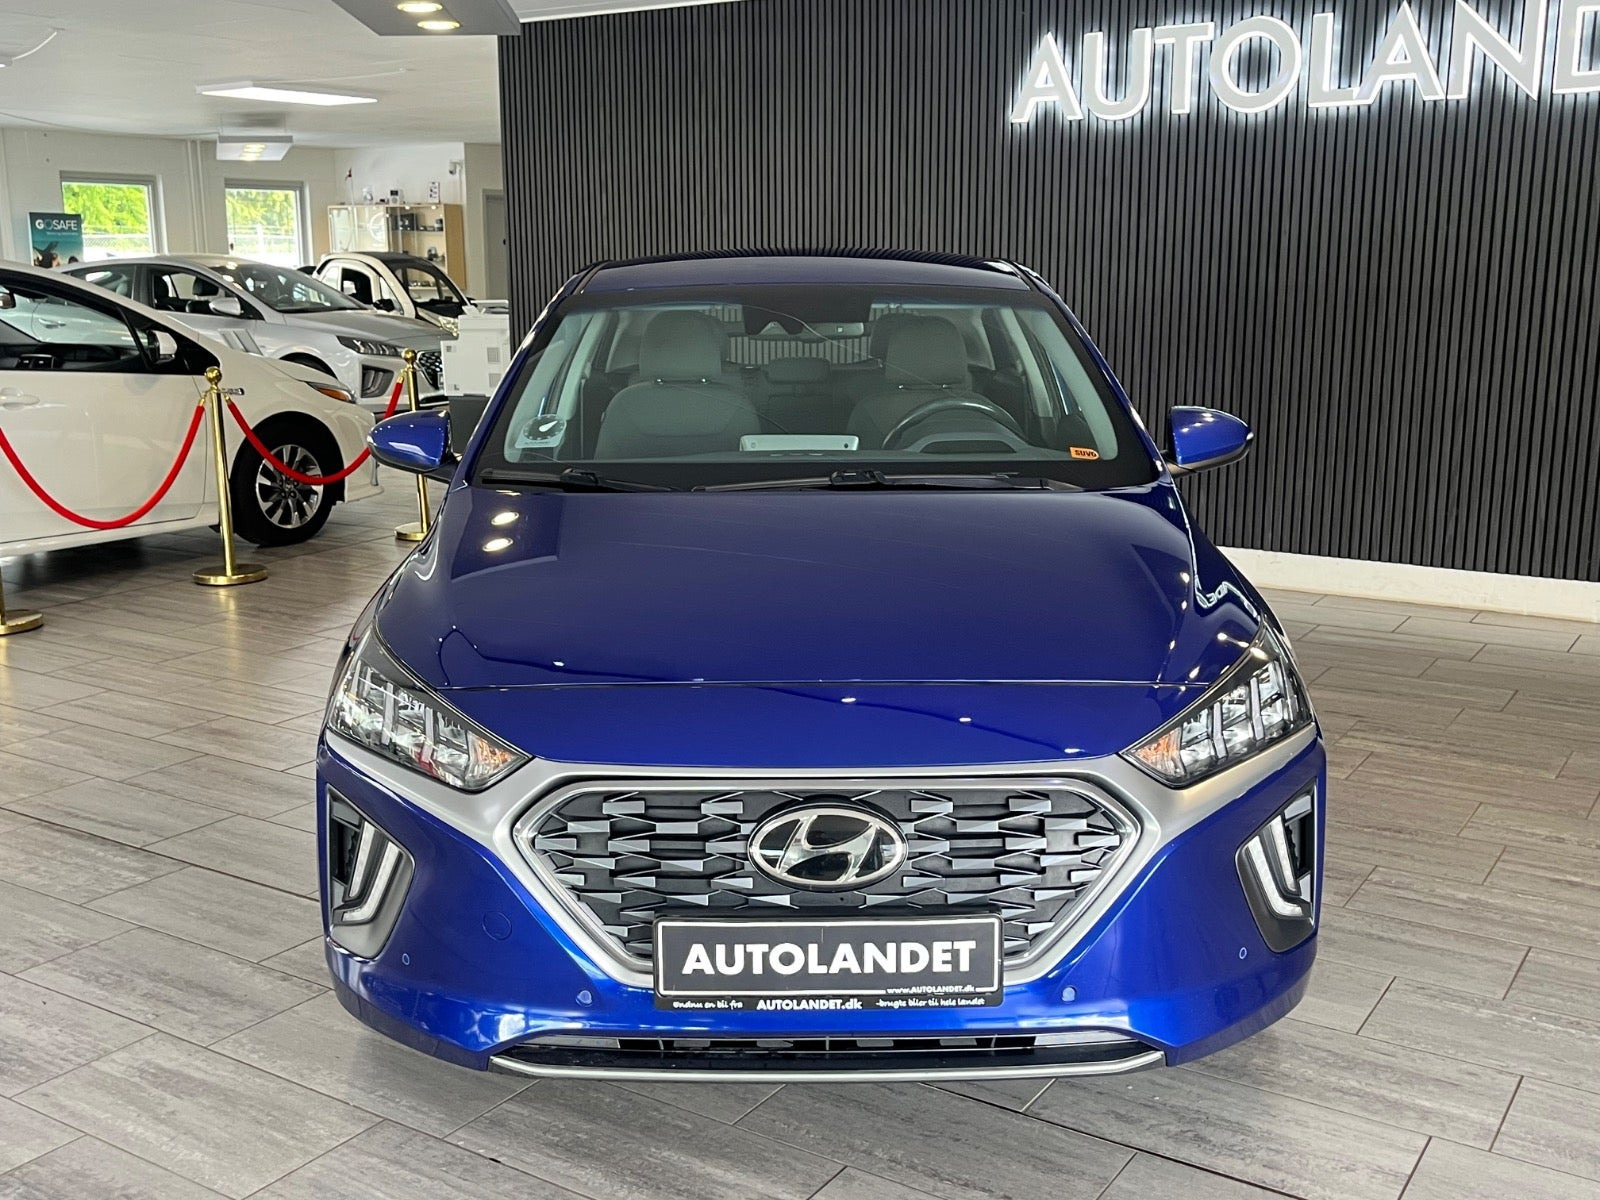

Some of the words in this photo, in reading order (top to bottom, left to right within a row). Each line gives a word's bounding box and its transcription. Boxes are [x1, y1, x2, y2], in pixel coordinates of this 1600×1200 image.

[35, 219, 78, 231] GOSAFE
[682, 940, 977, 975] AUTOLANDET
[886, 984, 975, 994] www.AUTOLANDET.dk
[756, 998, 863, 1010] AUTOLANDET.dk
[908, 998, 927, 1007] biler
[928, 998, 940, 1007] til
[957, 997, 985, 1006] landet
